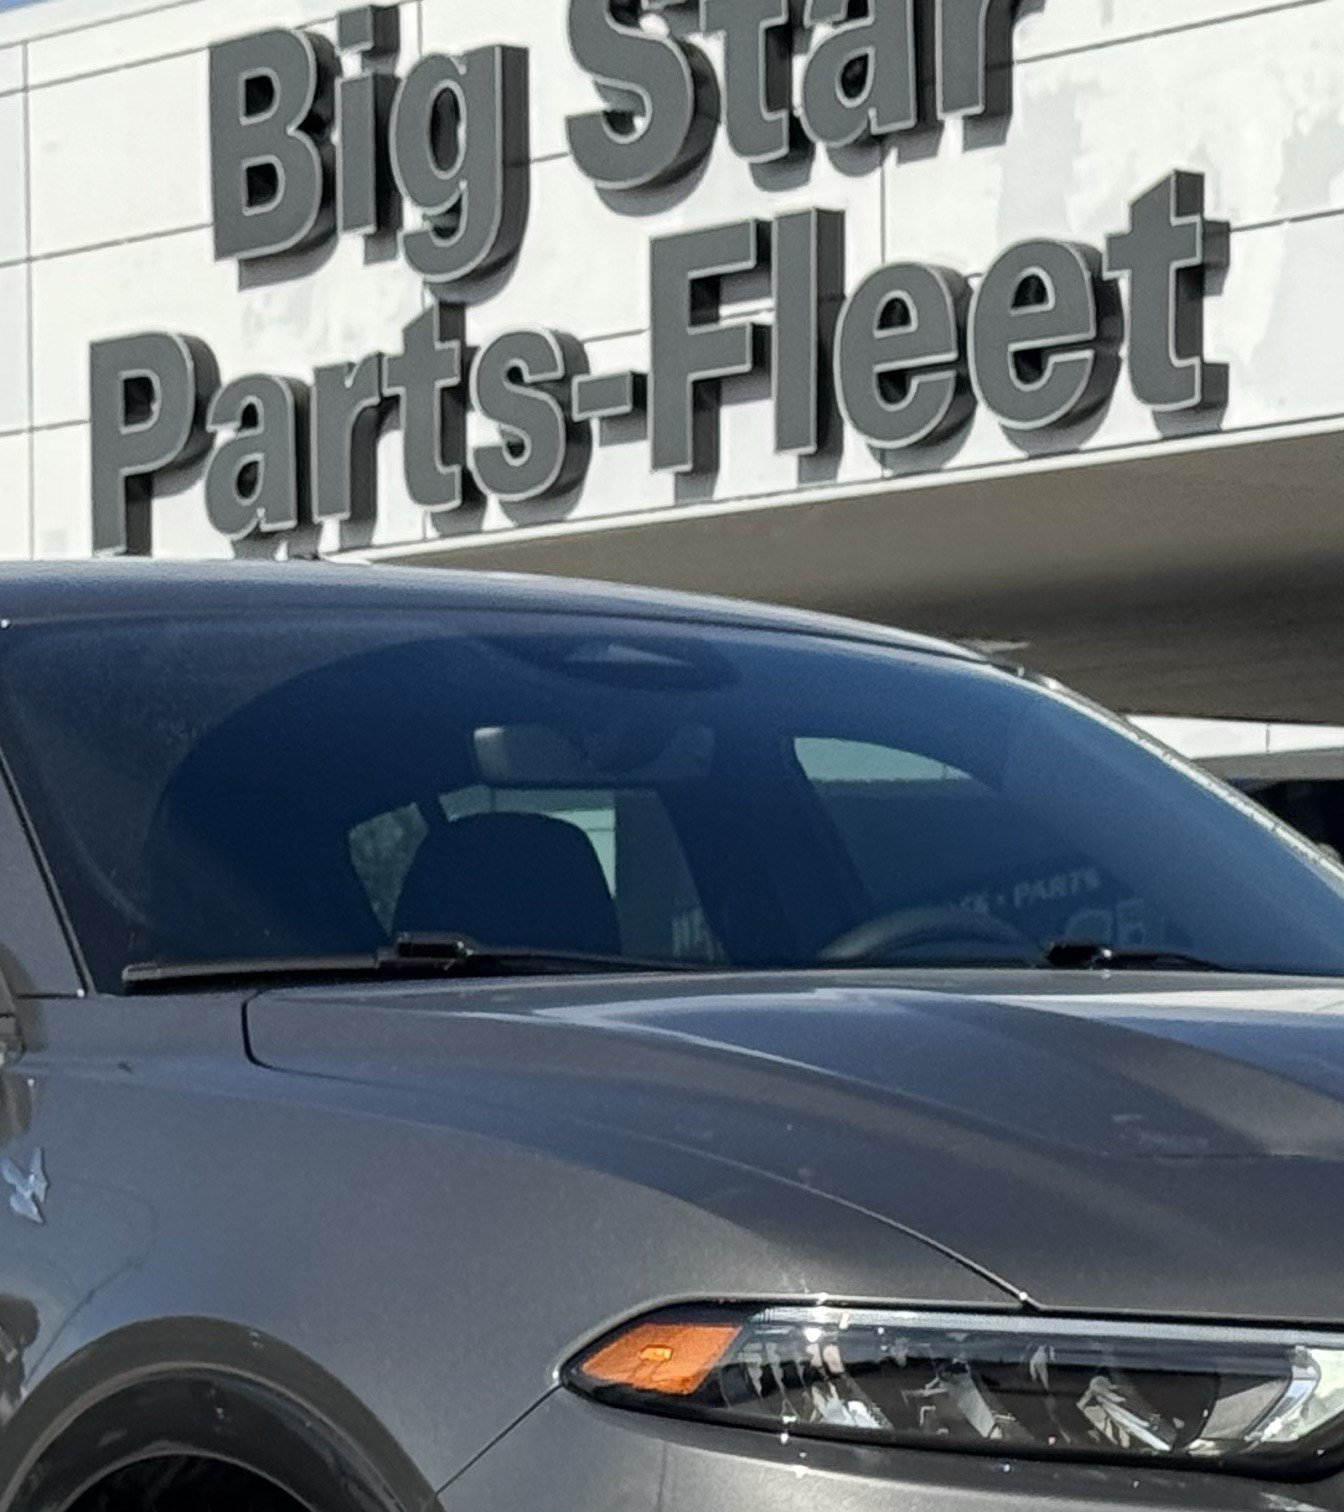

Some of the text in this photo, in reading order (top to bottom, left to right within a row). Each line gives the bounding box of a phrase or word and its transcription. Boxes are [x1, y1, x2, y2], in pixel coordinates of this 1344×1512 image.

[208, 0, 1044, 298] Big Star
[90, 170, 1231, 556] Parts-Fleet
